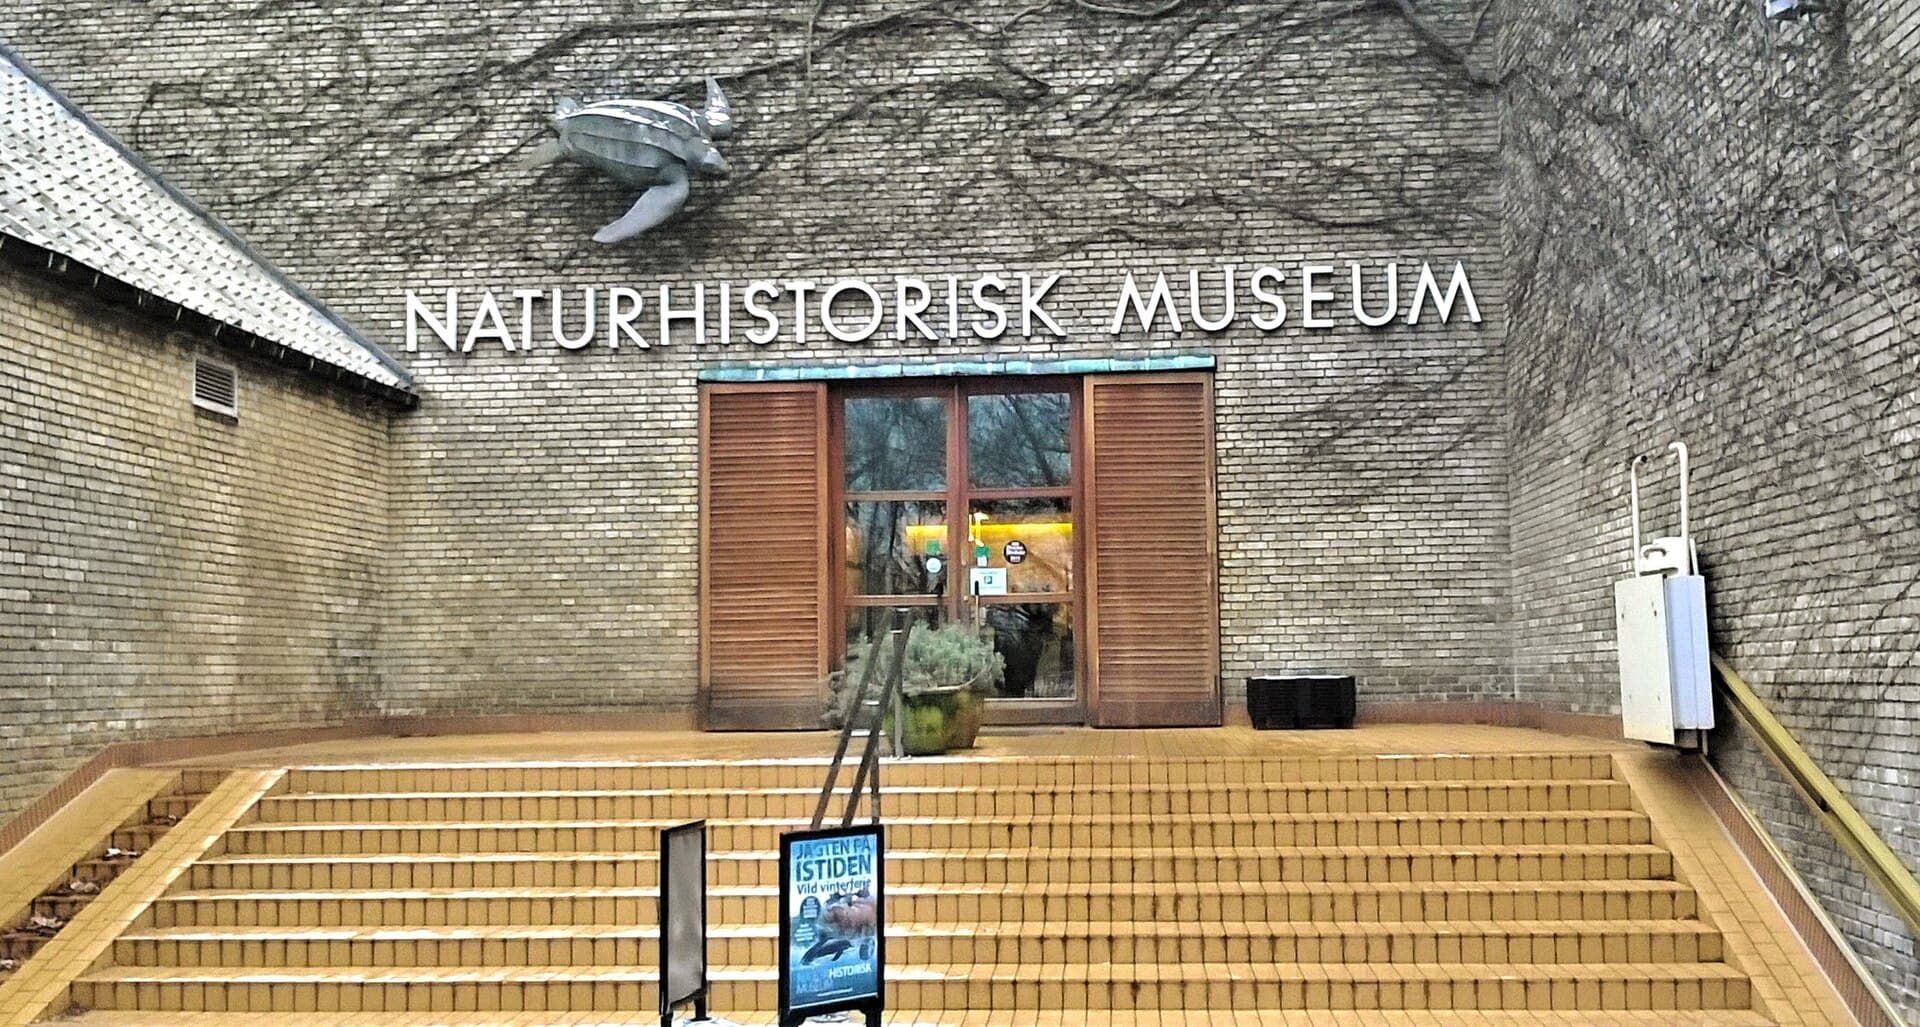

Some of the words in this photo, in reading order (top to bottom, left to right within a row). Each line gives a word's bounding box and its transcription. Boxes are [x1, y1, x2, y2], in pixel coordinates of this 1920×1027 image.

[405, 272, 1066, 352] NATURHISTORISK
[1110, 260, 1482, 335] MUSEUM
[796, 840, 850, 860] JAGTEN
[796, 854, 872, 882] ISTIDEN
[797, 881, 818, 895] Vild
[820, 878, 872, 894] vinterferie
